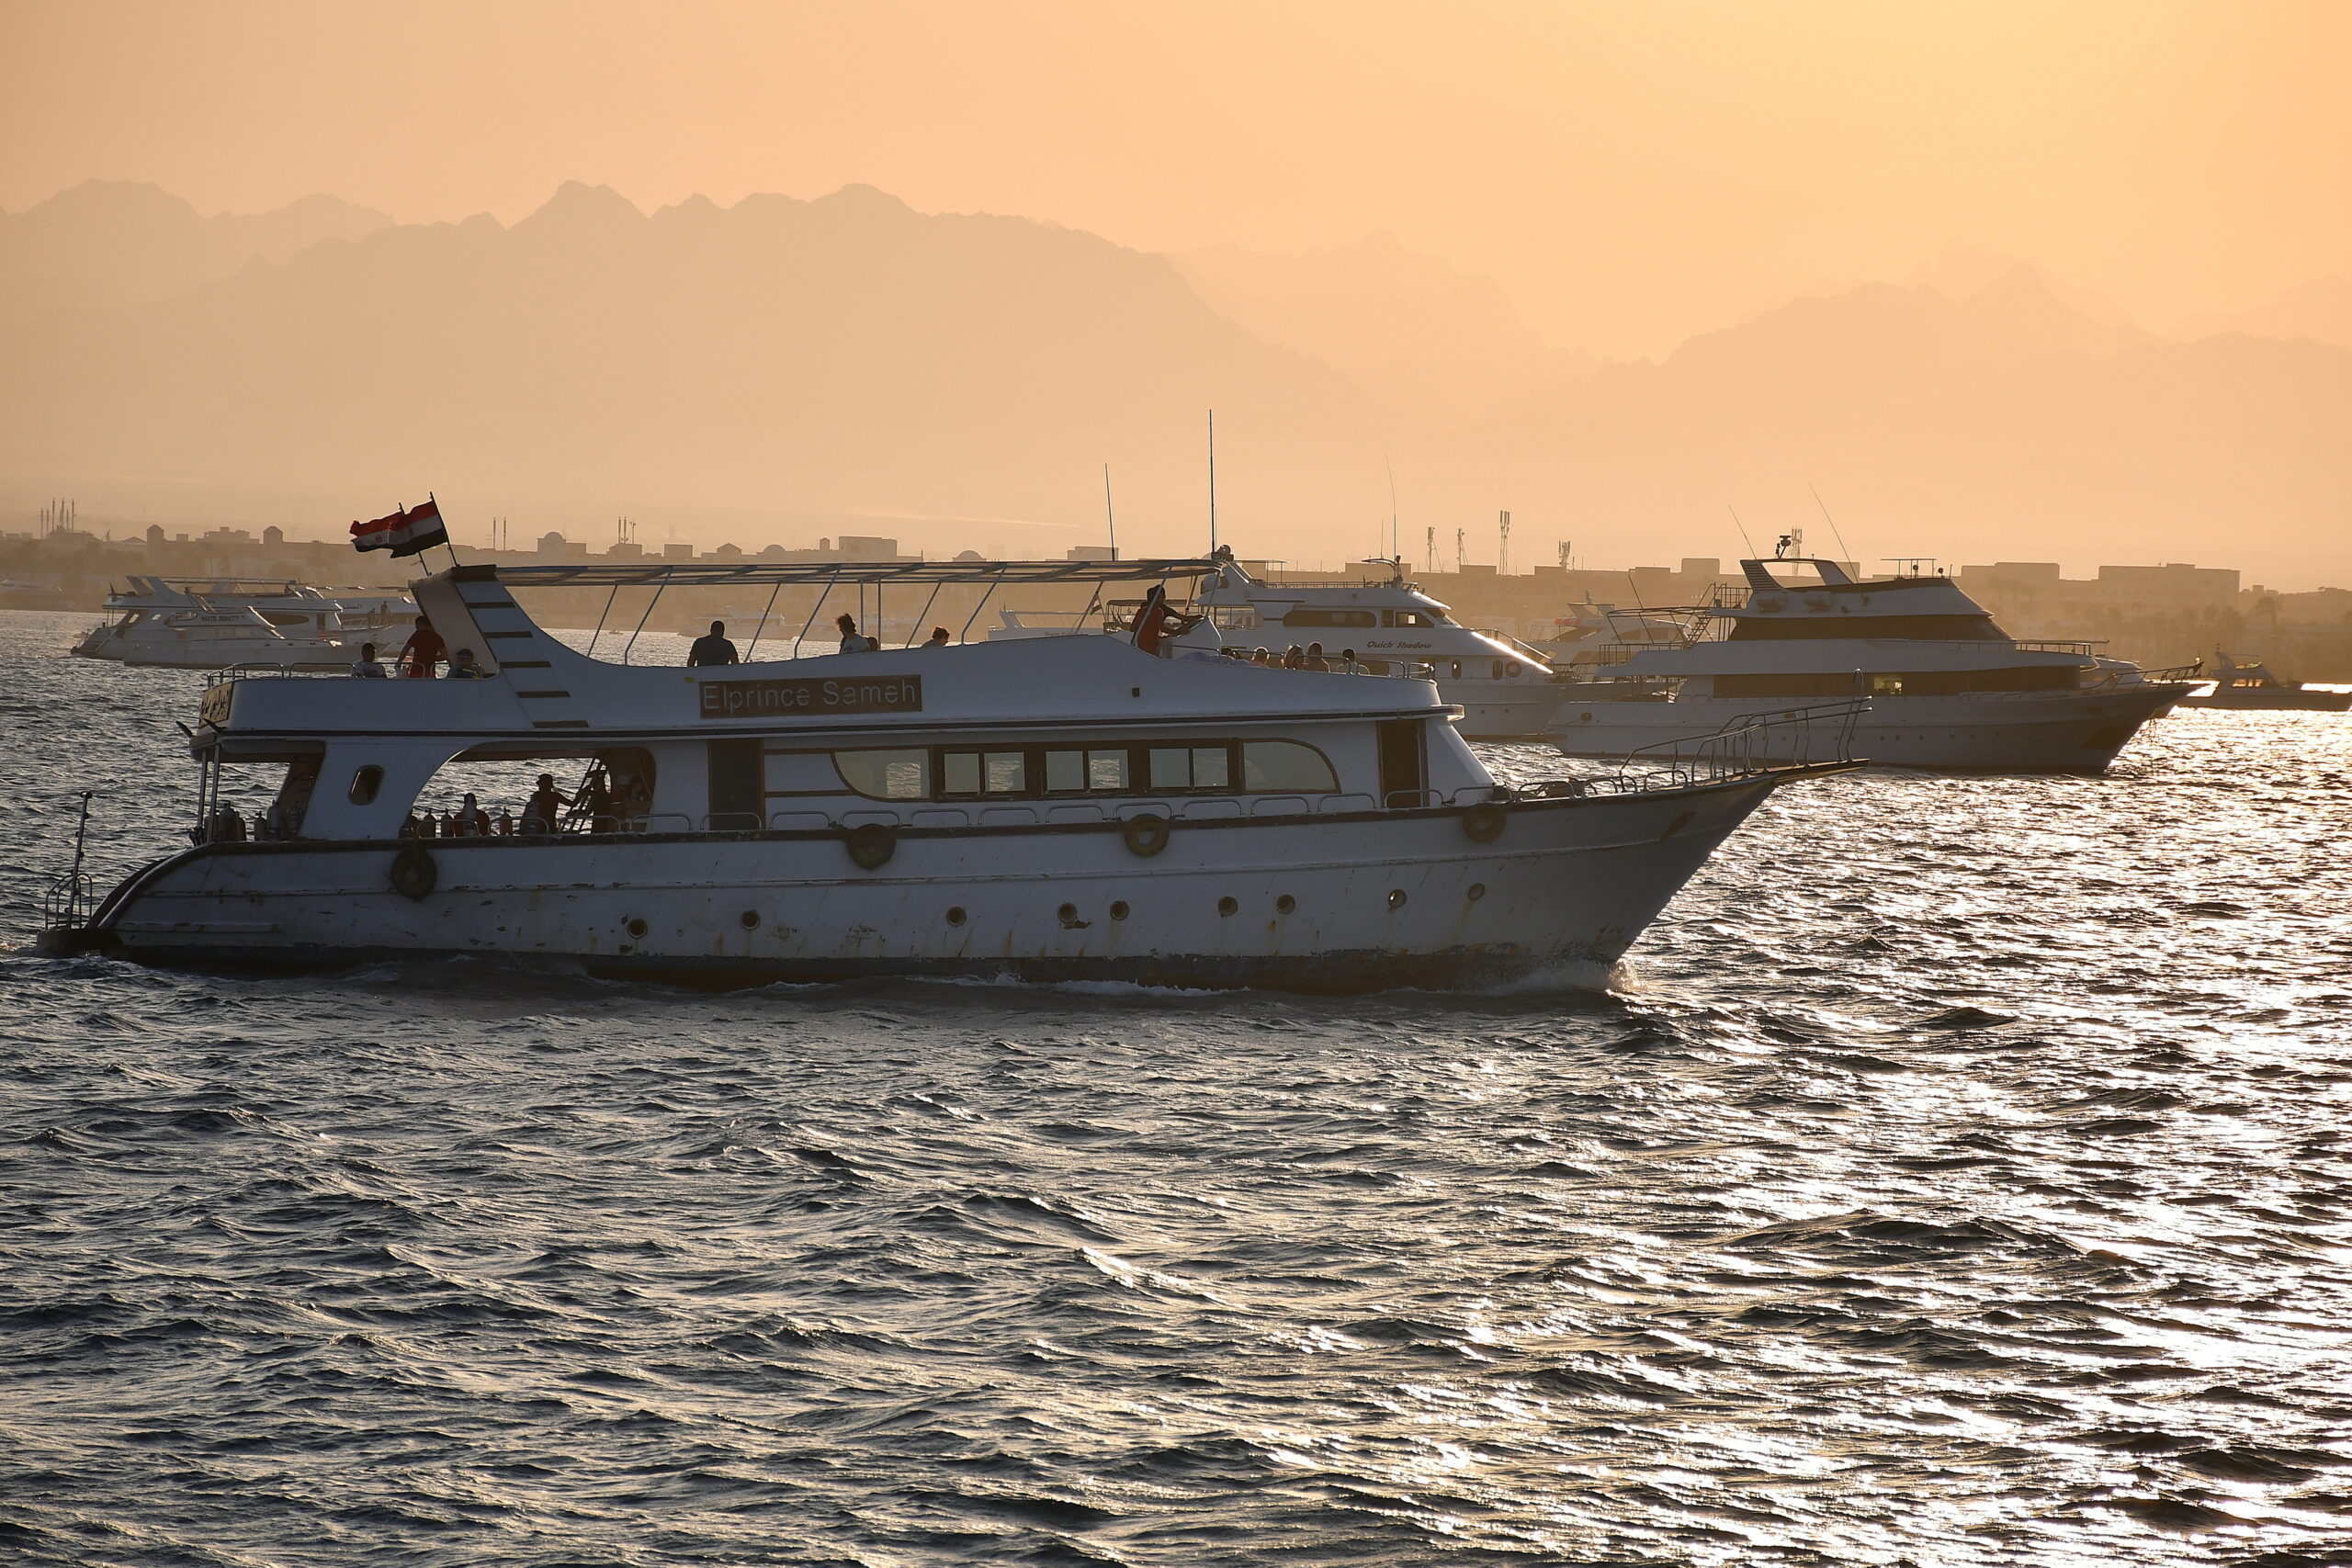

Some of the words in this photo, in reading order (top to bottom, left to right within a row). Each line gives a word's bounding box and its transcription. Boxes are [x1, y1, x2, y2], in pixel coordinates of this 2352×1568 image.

[1367, 640, 1394, 649] Quick
[703, 683, 810, 714] Elprince
[822, 679, 916, 705] Sameh
